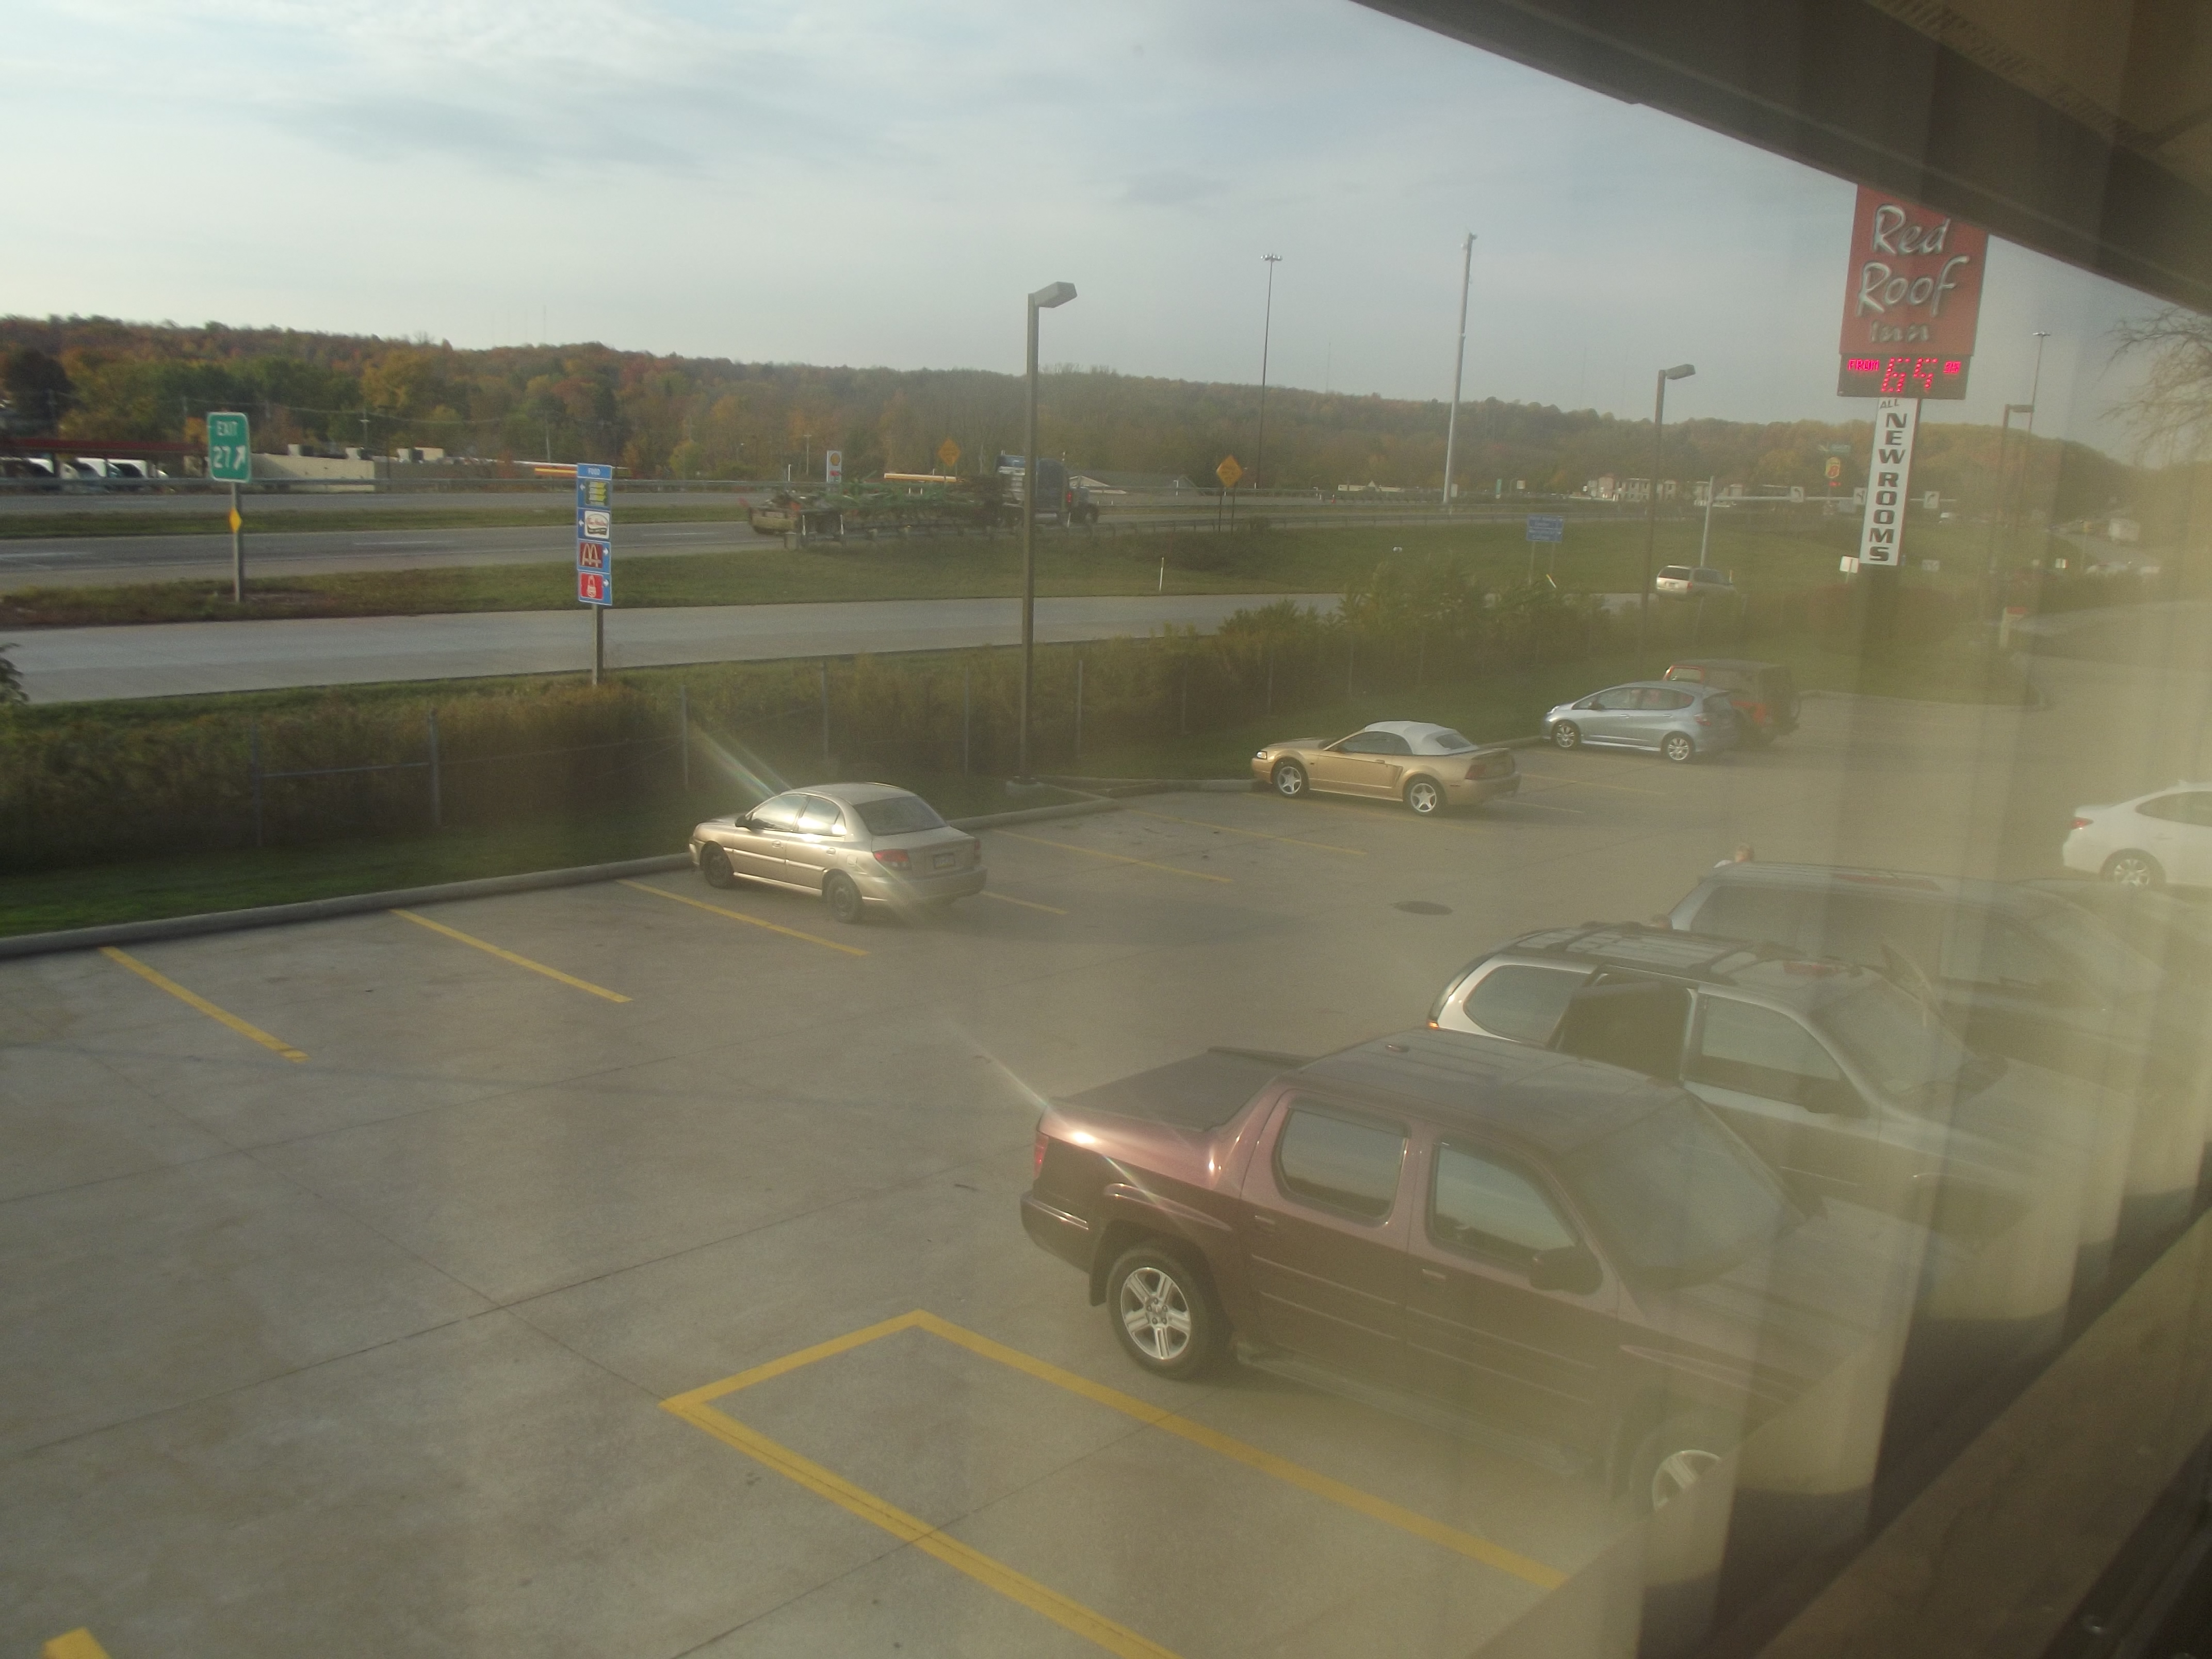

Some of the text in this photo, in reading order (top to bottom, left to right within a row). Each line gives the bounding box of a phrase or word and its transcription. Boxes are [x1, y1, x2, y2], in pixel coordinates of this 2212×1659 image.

[1872, 204, 1951, 255] Red
[1856, 255, 1970, 317] Roof
[1848, 359, 1879, 371] FROM
[1879, 398, 1900, 409] ALL
[217, 420, 238, 436] EXIT
[213, 445, 232, 468] 27
[1868, 413, 1908, 562] NEW ROOMS
